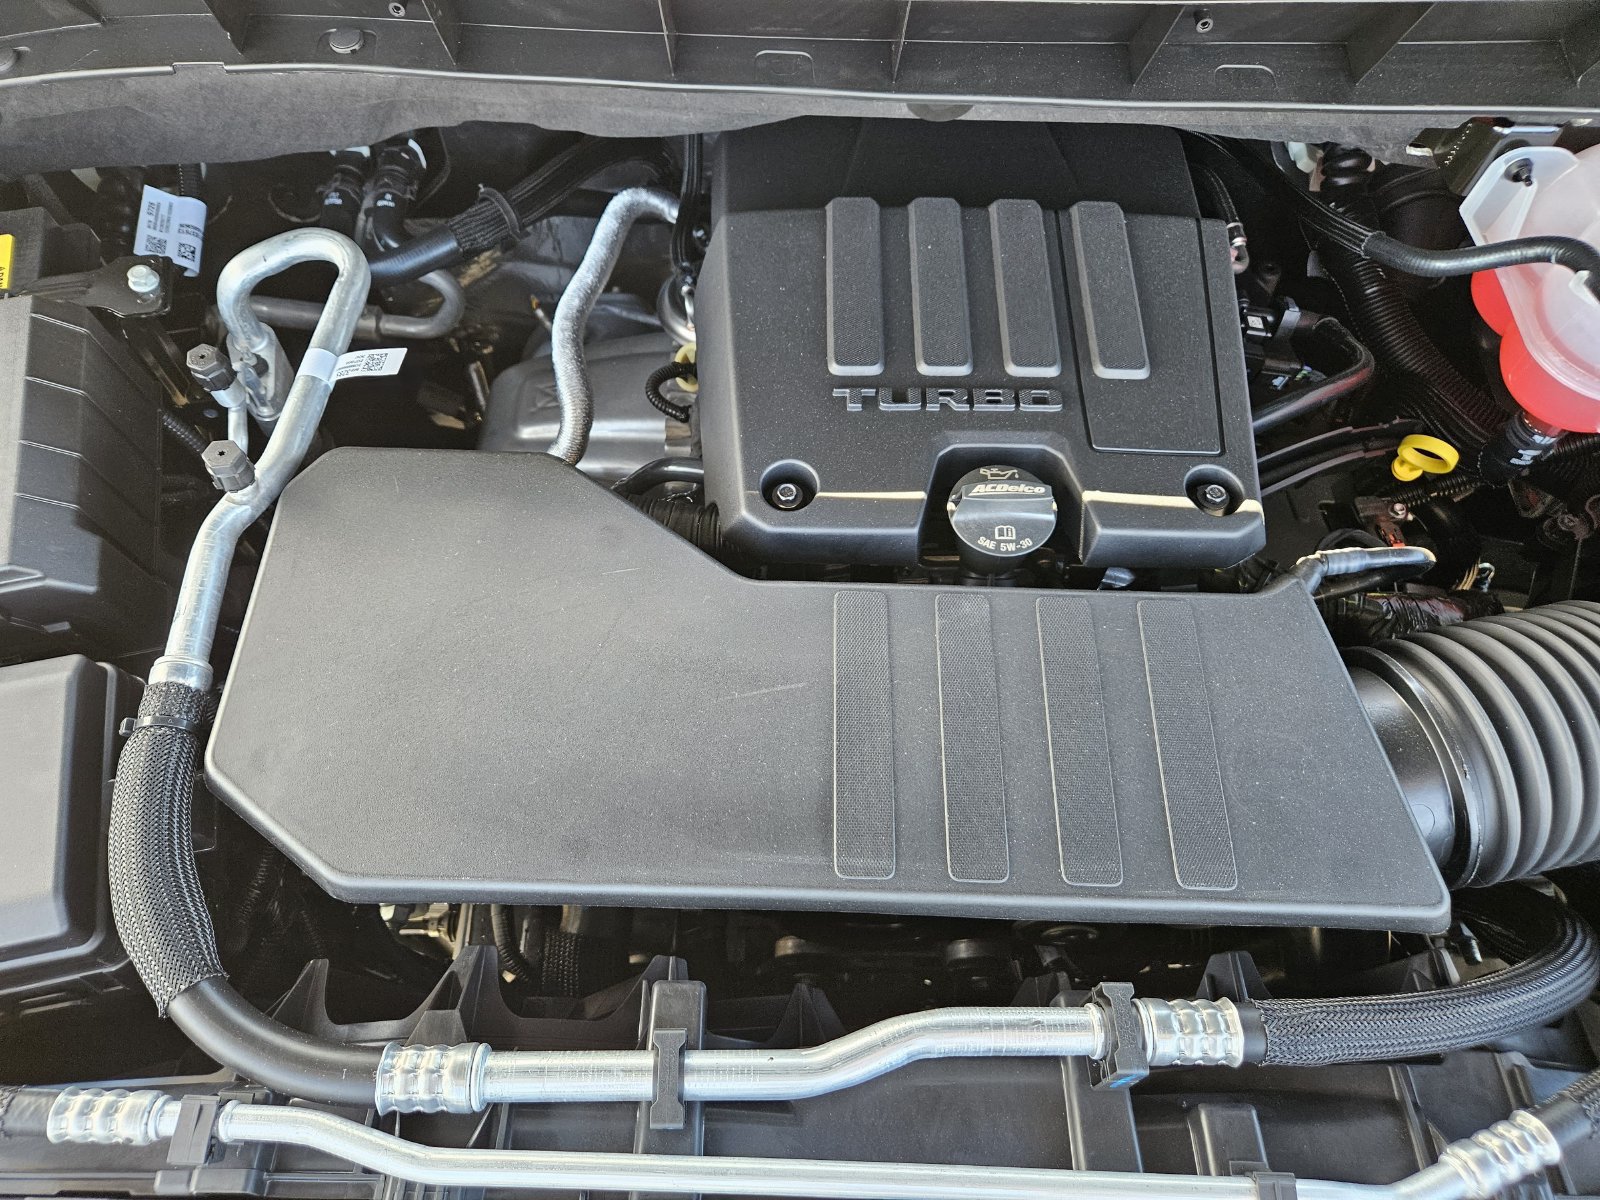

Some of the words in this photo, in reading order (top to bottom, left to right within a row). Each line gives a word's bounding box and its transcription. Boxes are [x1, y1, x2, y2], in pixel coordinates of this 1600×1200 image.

[832, 387, 1063, 412] TURBO
[969, 483, 1046, 495] ACDelco
[977, 536, 997, 550] SAE
[1000, 537, 1033, 552] 5W-30
